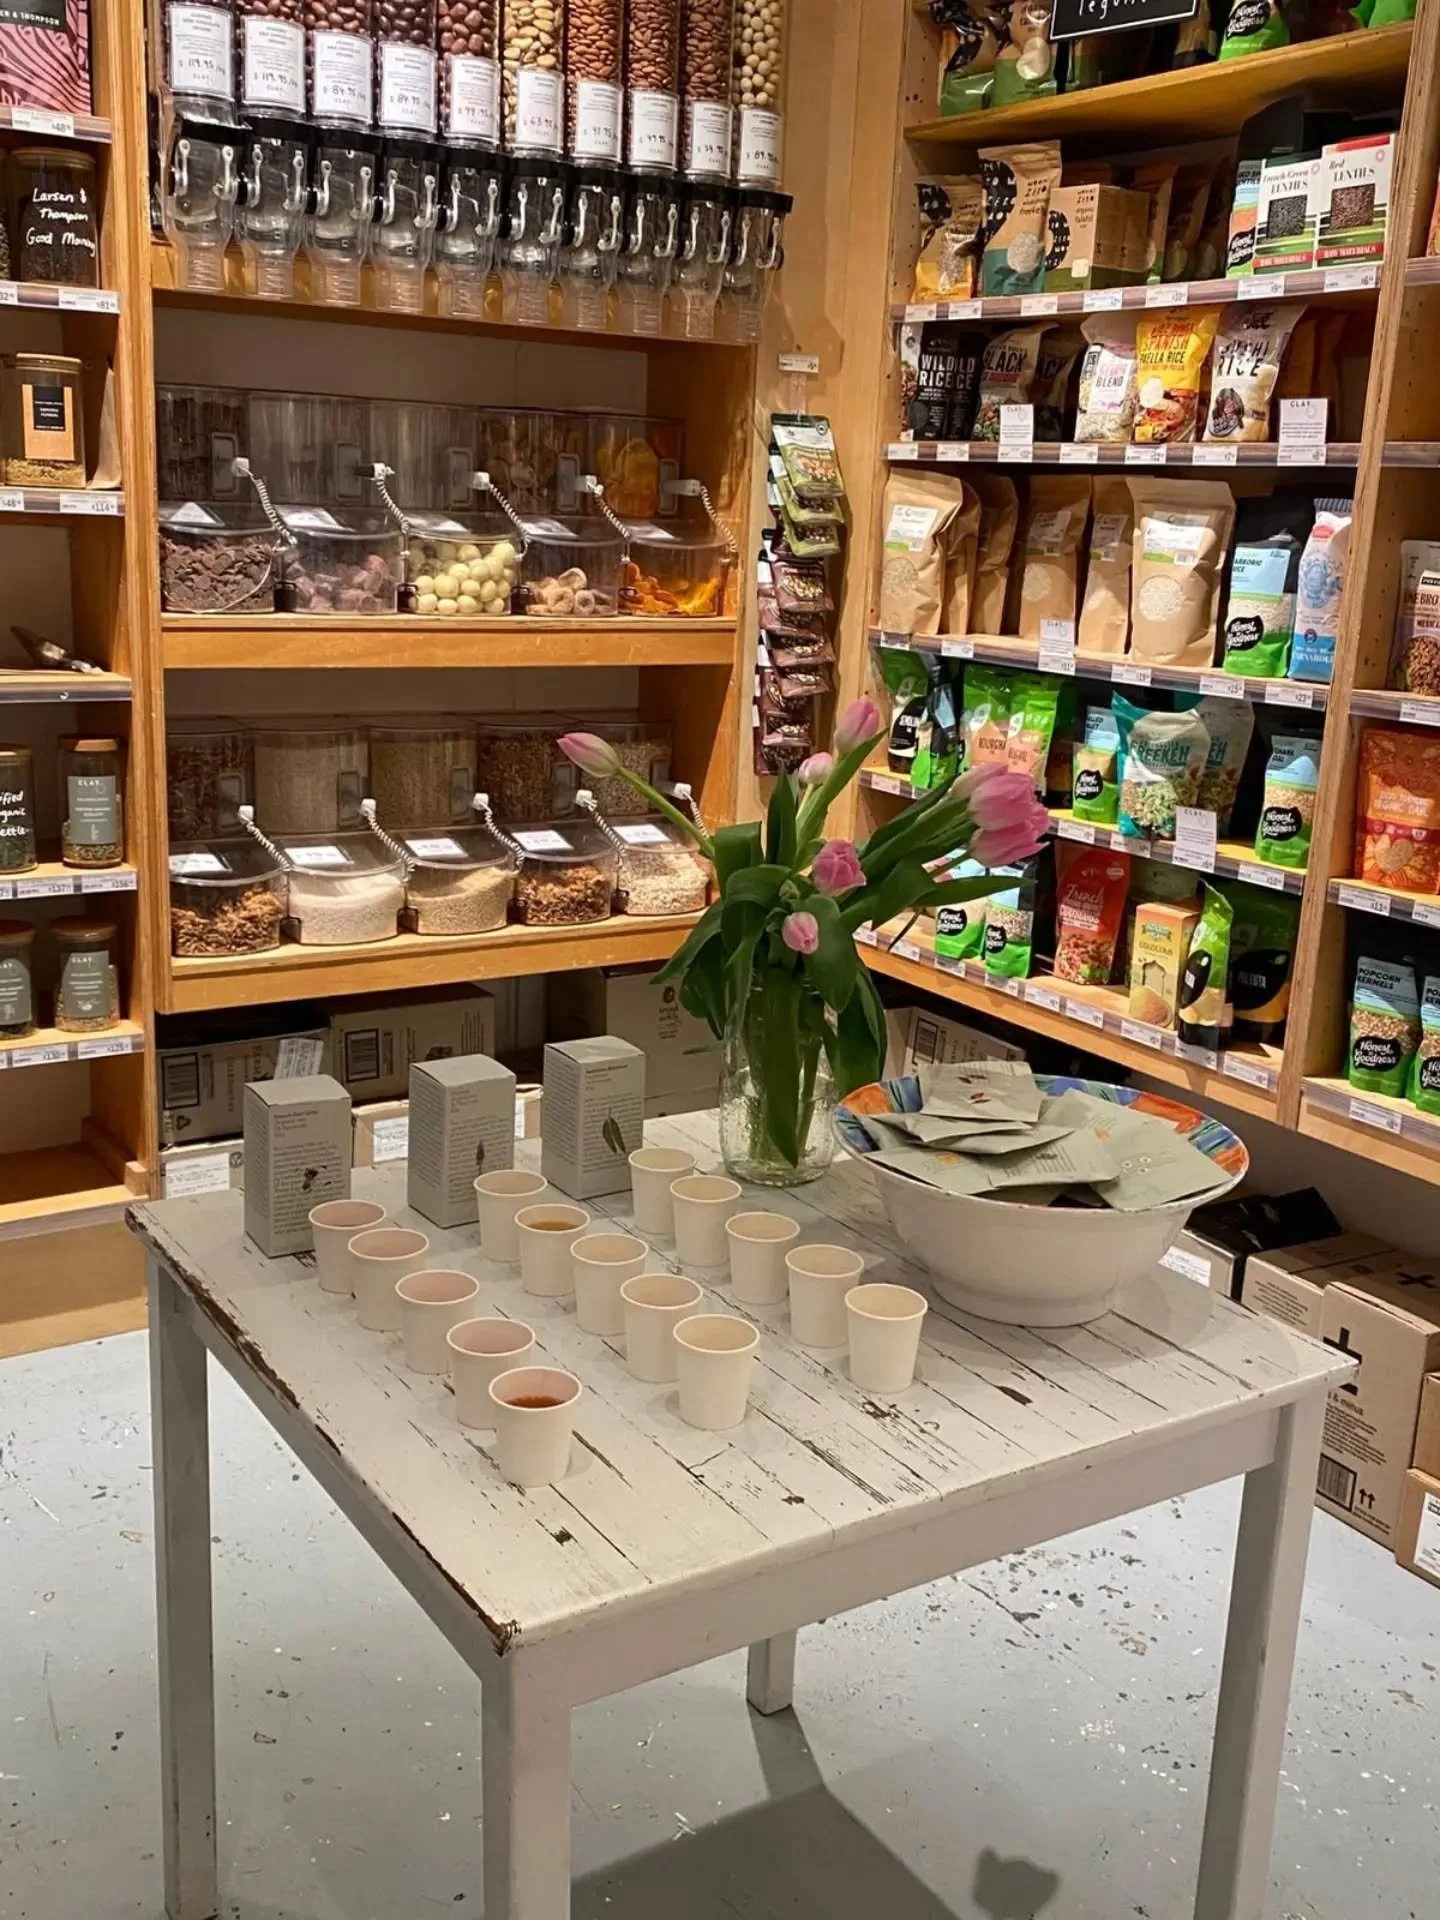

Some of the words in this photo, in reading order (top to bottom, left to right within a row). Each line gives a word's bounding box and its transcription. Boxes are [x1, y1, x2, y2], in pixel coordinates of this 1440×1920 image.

[20, 12, 60, 26] THOMPSON
[1333, 166, 1375, 183] LENTILS
[32, 188, 74, 203] Larsen
[40, 208, 89, 223] Thompson
[26, 227, 53, 245] Good
[921, 353, 956, 372] WILD
[919, 370, 951, 389] RICE
[78, 779, 100, 787] CLAY
[1357, 975, 1394, 990] KERNELS
[1359, 967, 1401, 983] POPCORN
[1360, 1041, 1393, 1056] Honest
[1354, 1049, 1397, 1066] Goodness
